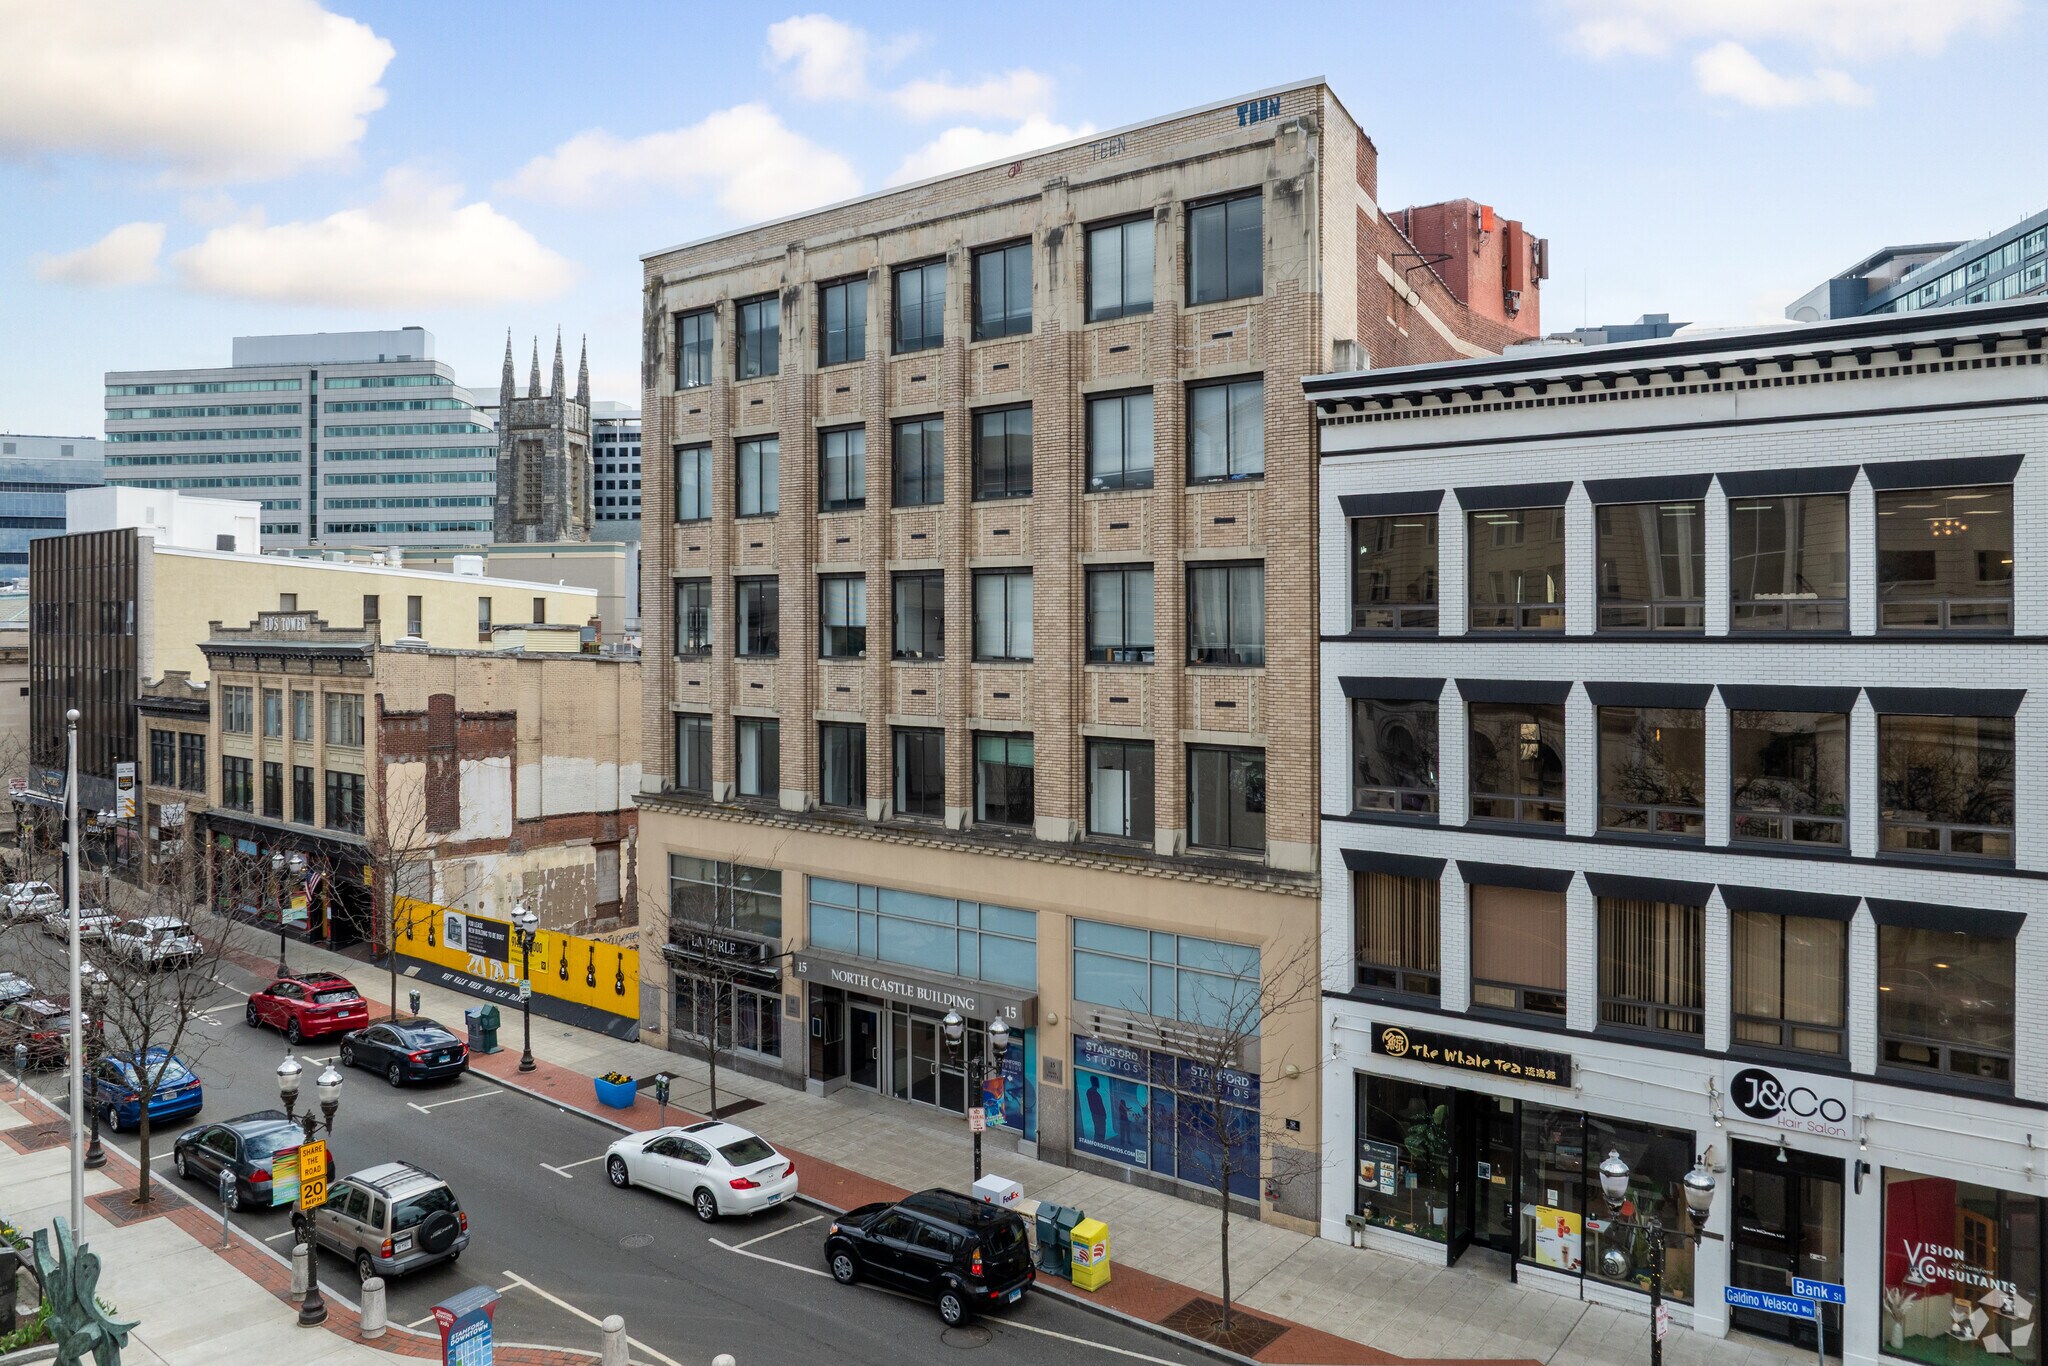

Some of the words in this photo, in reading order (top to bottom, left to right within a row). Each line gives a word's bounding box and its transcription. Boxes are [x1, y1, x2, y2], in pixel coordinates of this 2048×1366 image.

[1088, 137, 1126, 161] TEEN
[264, 616, 279, 631] ED'S
[281, 617, 306, 631] TOWER
[691, 935, 702, 948] LA
[706, 938, 736, 955] PERLE
[441, 972, 454, 981] WHY
[453, 976, 468, 986] WALK
[467, 980, 484, 990] WHEN
[482, 985, 496, 994] YOU
[495, 989, 510, 998] CAN
[508, 993, 527, 1004] DANC
[798, 961, 807, 973] 15
[831, 968, 869, 987] NORTH
[871, 977, 914, 997] CASTLE
[917, 986, 975, 1010] BUILDING
[1004, 1005, 1017, 1019] 15
[1085, 1041, 1139, 1061] STAMFORD
[1412, 1044, 1439, 1059] The
[1444, 1048, 1490, 1068] Whale
[1494, 1059, 1521, 1074] Tea
[1085, 1055, 1138, 1073] STUDIOS
[1745, 1077, 1847, 1122] J&Co
[1777, 1115, 1802, 1129] Hair
[1807, 1120, 1846, 1136] Salon
[302, 1144, 323, 1157] SHARE
[1079, 1137, 1136, 1157] STAMFORDSTUDIOS.COM
[304, 1165, 322, 1176] ROAD
[307, 1156, 319, 1166] THE
[304, 1181, 323, 1199] 20
[1002, 1191, 1019, 1204] FedEx
[305, 1195, 323, 1206] MPH
[1903, 1239, 1965, 1266] VISION
[1918, 1256, 2017, 1295] CONSULTANTS
[1796, 1281, 1829, 1299] Bank
[1833, 1292, 1842, 1301] St
[1726, 1289, 1760, 1306] Galdino
[1762, 1295, 1799, 1313] Velasco
[1802, 1304, 1813, 1315] Way
[450, 1323, 489, 1346] DOWNTOWN
[451, 1319, 485, 1339] STAMFORD
